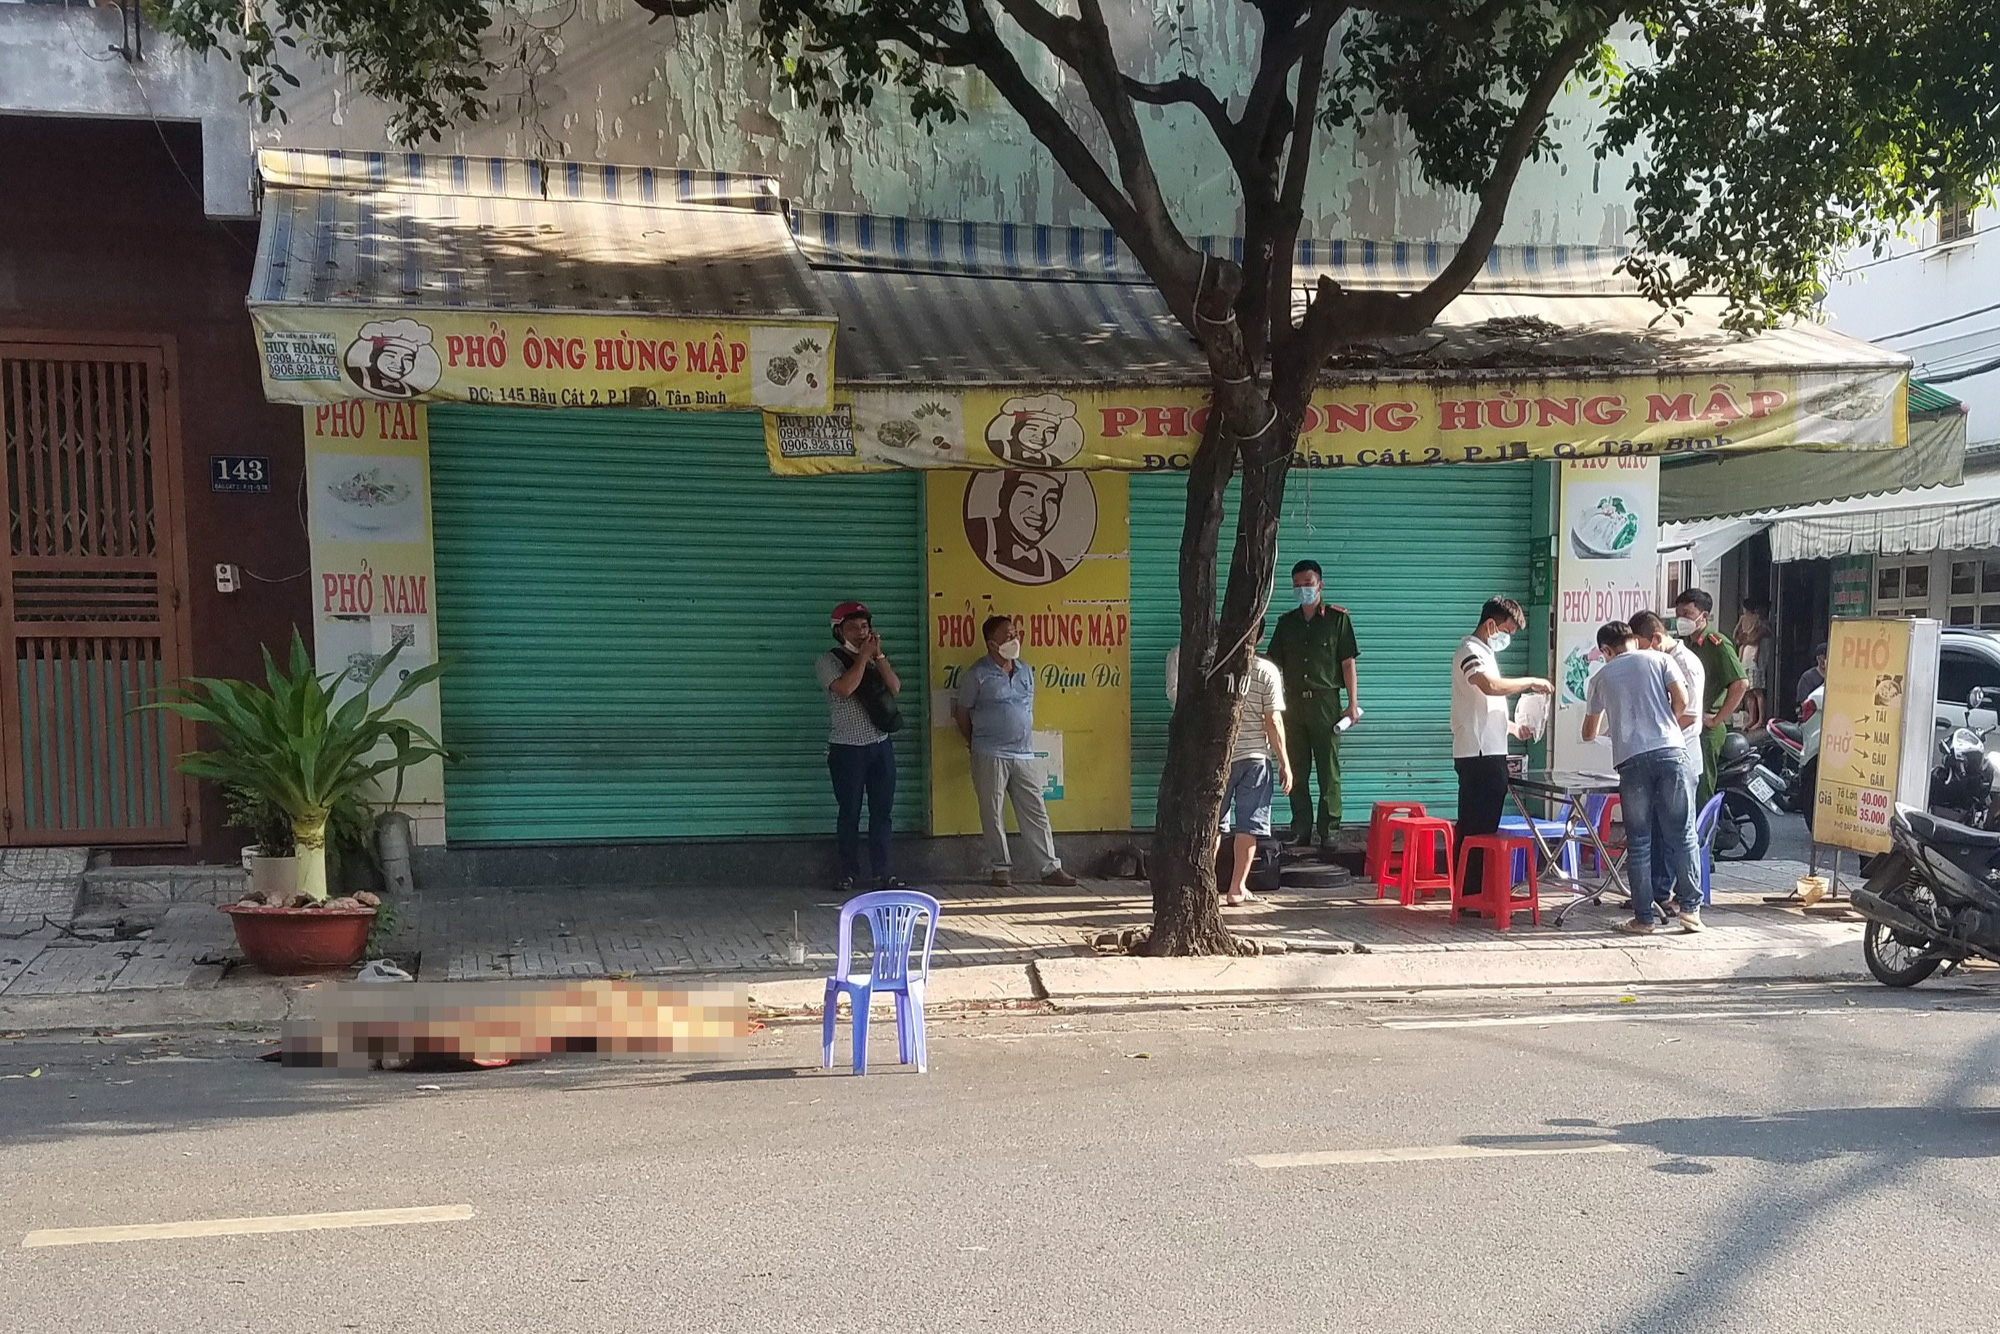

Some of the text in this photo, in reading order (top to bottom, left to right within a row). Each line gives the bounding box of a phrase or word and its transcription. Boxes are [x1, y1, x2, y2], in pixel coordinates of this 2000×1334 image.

[265, 339, 336, 355] HUY HOÀNG
[445, 321, 748, 381] PHỞ ÔNG HÙNG MẬP
[499, 387, 526, 402] 145
[529, 387, 557, 405] Bàu
[561, 387, 586, 406] Cát
[665, 389, 691, 405] Tân
[695, 390, 727, 405] Bình
[1437, 390, 1627, 430] HÙNG
[1645, 383, 1787, 428] MẬP
[779, 415, 802, 428] HUY
[781, 438, 853, 451] 0906.926.616
[1356, 448, 1412, 466] Cát
[1598, 439, 1654, 457] Tân
[217, 458, 263, 481] 143
[322, 558, 373, 613] PHỞ
[1562, 577, 1591, 623] PHỞ
[1594, 580, 1615, 622] BÒ
[937, 599, 975, 648] PHỞ
[1030, 604, 1083, 647] HÙNG
[1088, 604, 1127, 655] MẬP
[1841, 626, 1891, 671] PHỞ
[1040, 663, 1087, 694] Đậm
[1091, 663, 1121, 688] Đà
[1825, 731, 1852, 754] PHỞ
[1818, 790, 1832, 806] Giá
[1861, 791, 1888, 809] 40.000
[1859, 808, 1886, 825] 35.000
